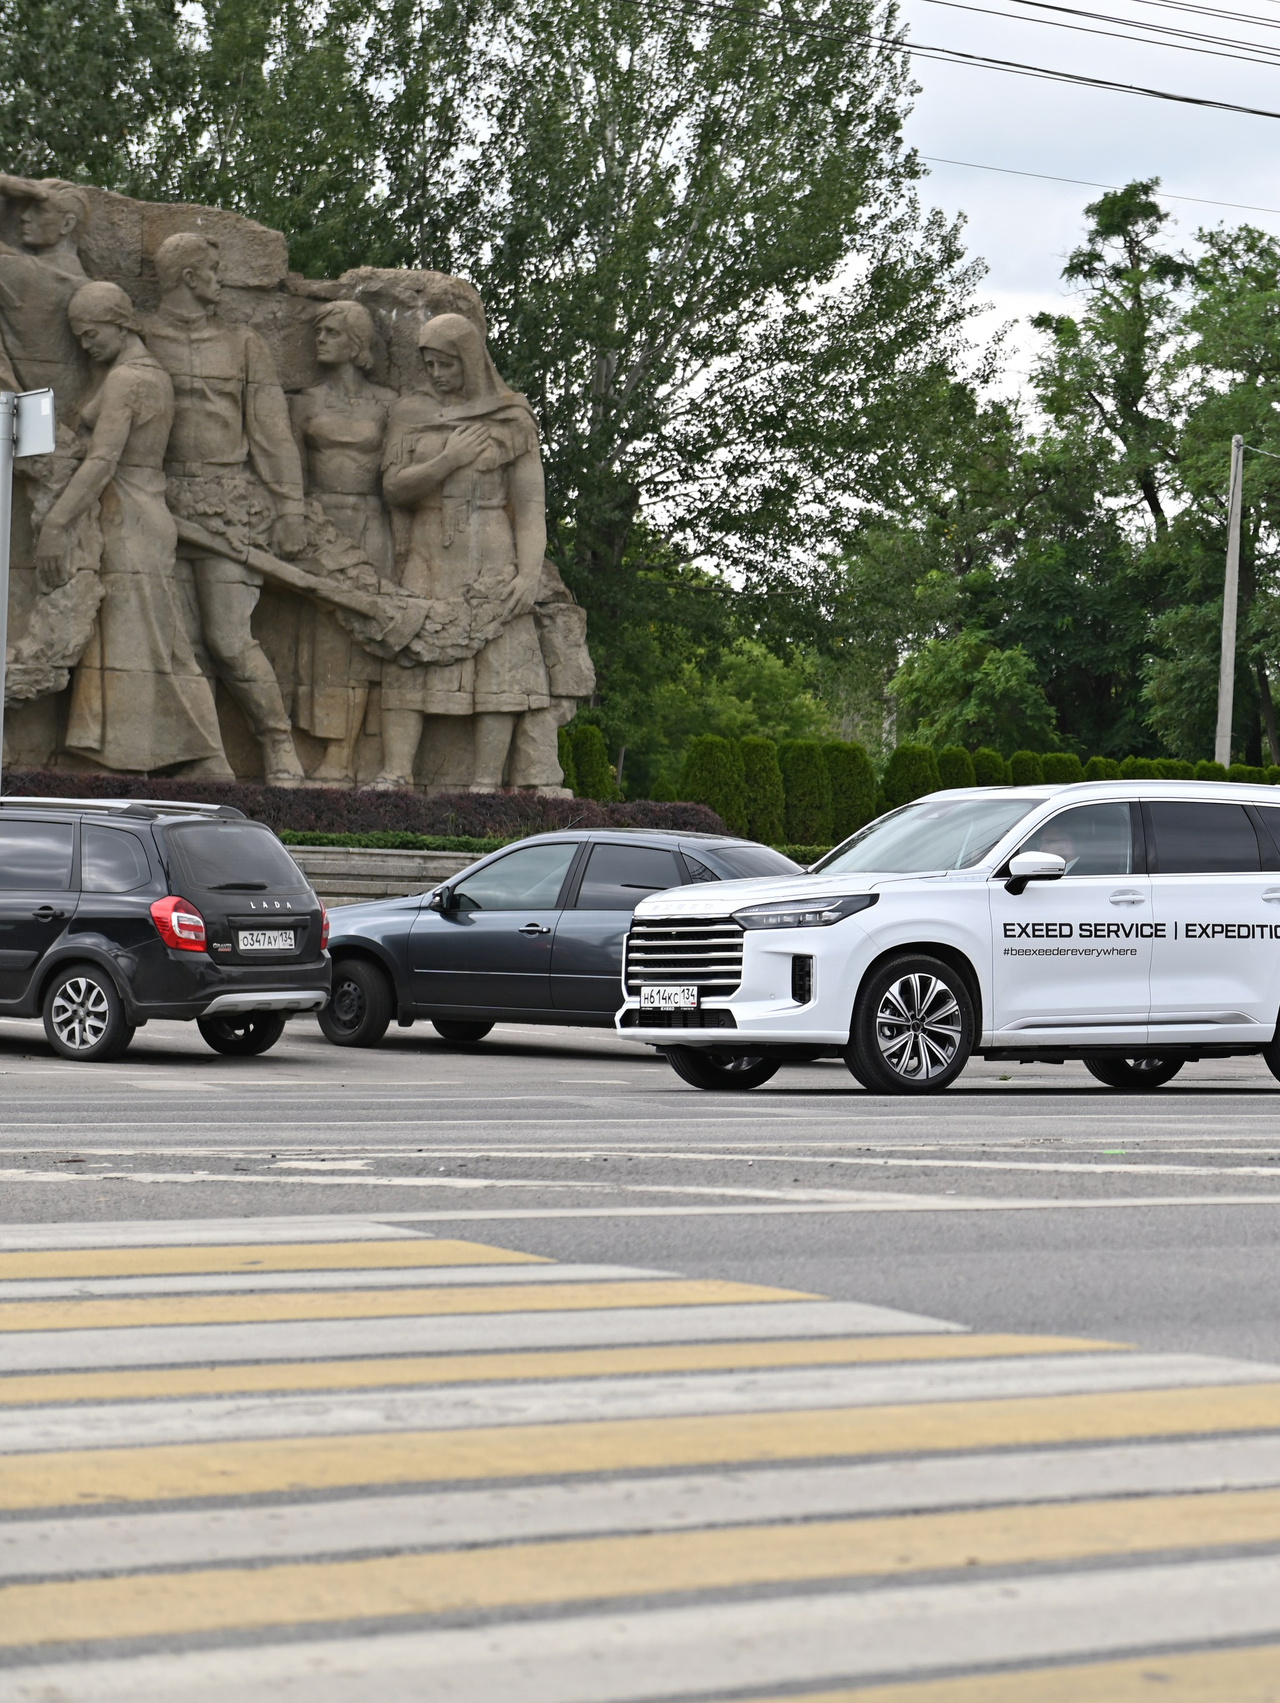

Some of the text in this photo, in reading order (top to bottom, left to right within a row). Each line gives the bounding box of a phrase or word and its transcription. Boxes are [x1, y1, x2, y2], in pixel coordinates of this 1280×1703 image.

[249, 901, 292, 909] LADA
[1003, 922, 1074, 939] EXEED
[1079, 923, 1167, 939] SERVICE
[279, 932, 293, 943] 134
[1003, 947, 1138, 957] #beexeedereverywhere
[681, 988, 696, 1001] 134
